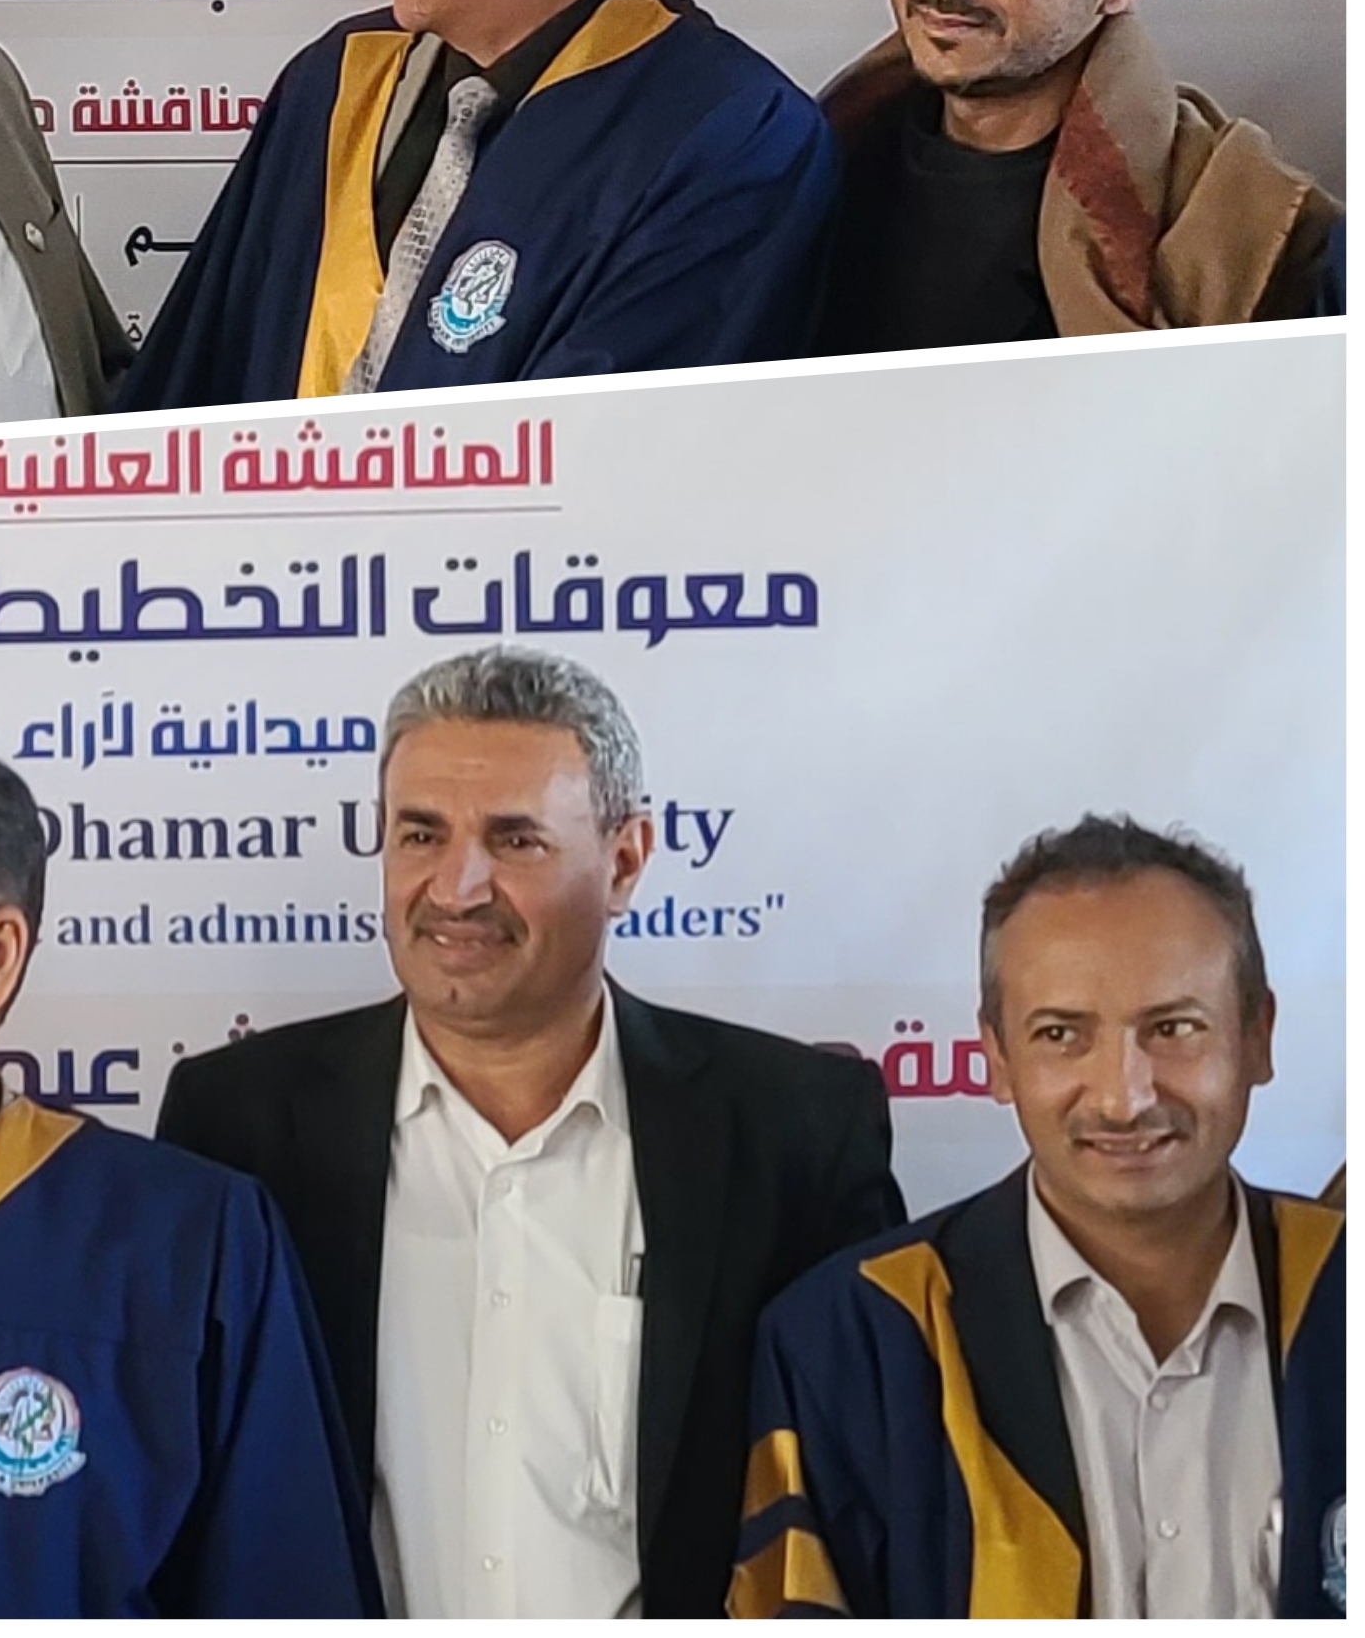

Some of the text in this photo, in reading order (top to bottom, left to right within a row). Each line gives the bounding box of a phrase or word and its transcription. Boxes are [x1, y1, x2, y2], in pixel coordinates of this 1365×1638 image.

[221, 419, 554, 494] المناقشة
[412, 550, 819, 649] معوقات
[150, 698, 377, 770] ميدانية
[56, 904, 152, 946] and
[168, 902, 386, 945] adminis
[612, 893, 786, 939] aders"
